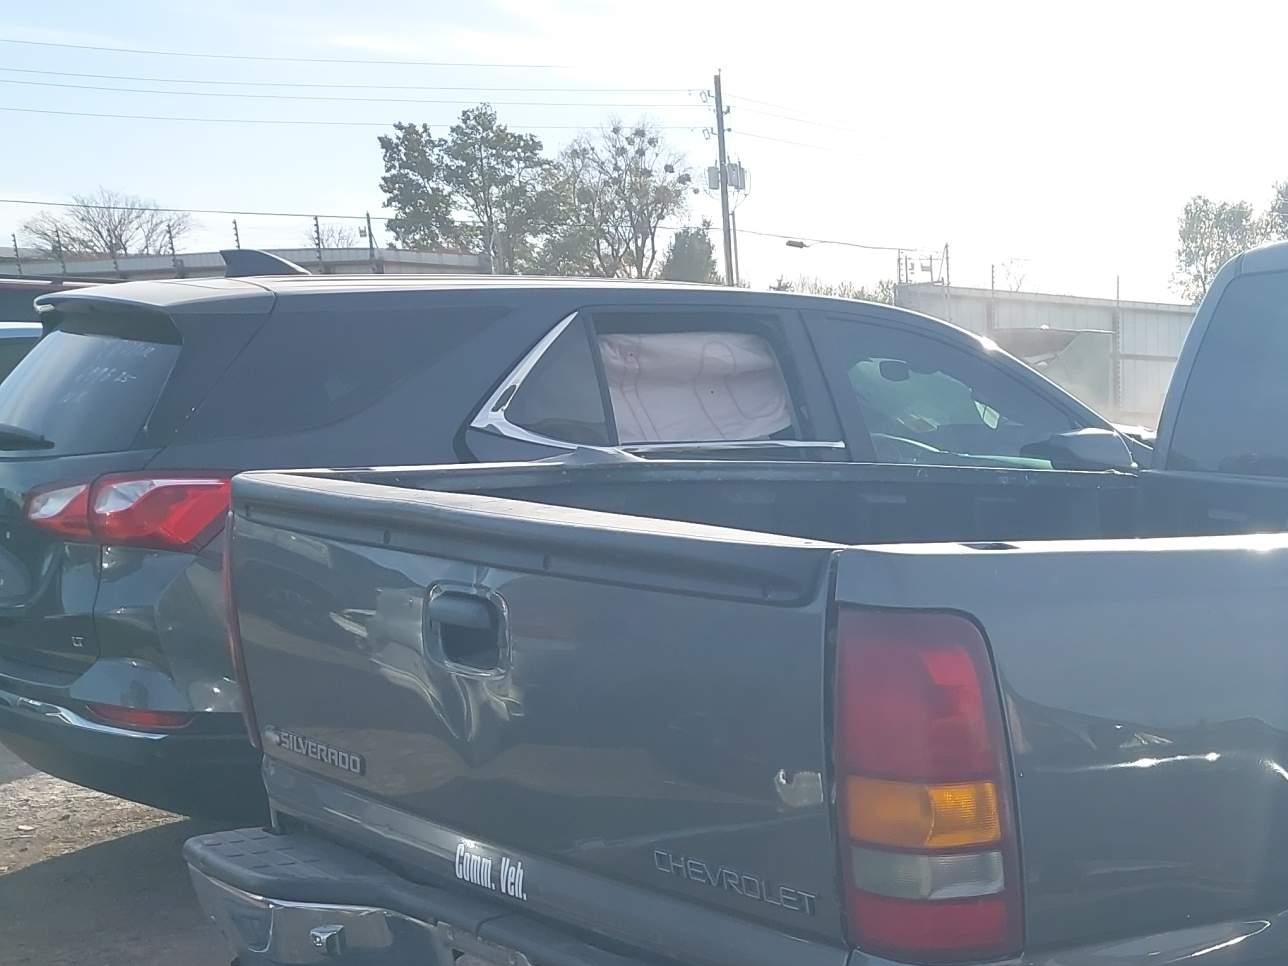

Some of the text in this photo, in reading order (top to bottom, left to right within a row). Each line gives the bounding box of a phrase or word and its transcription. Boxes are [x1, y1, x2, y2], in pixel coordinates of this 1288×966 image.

[279, 731, 361, 773] SILVERADO
[455, 843, 527, 901] Comm. Veh.
[654, 849, 817, 916] CHEVROLET
